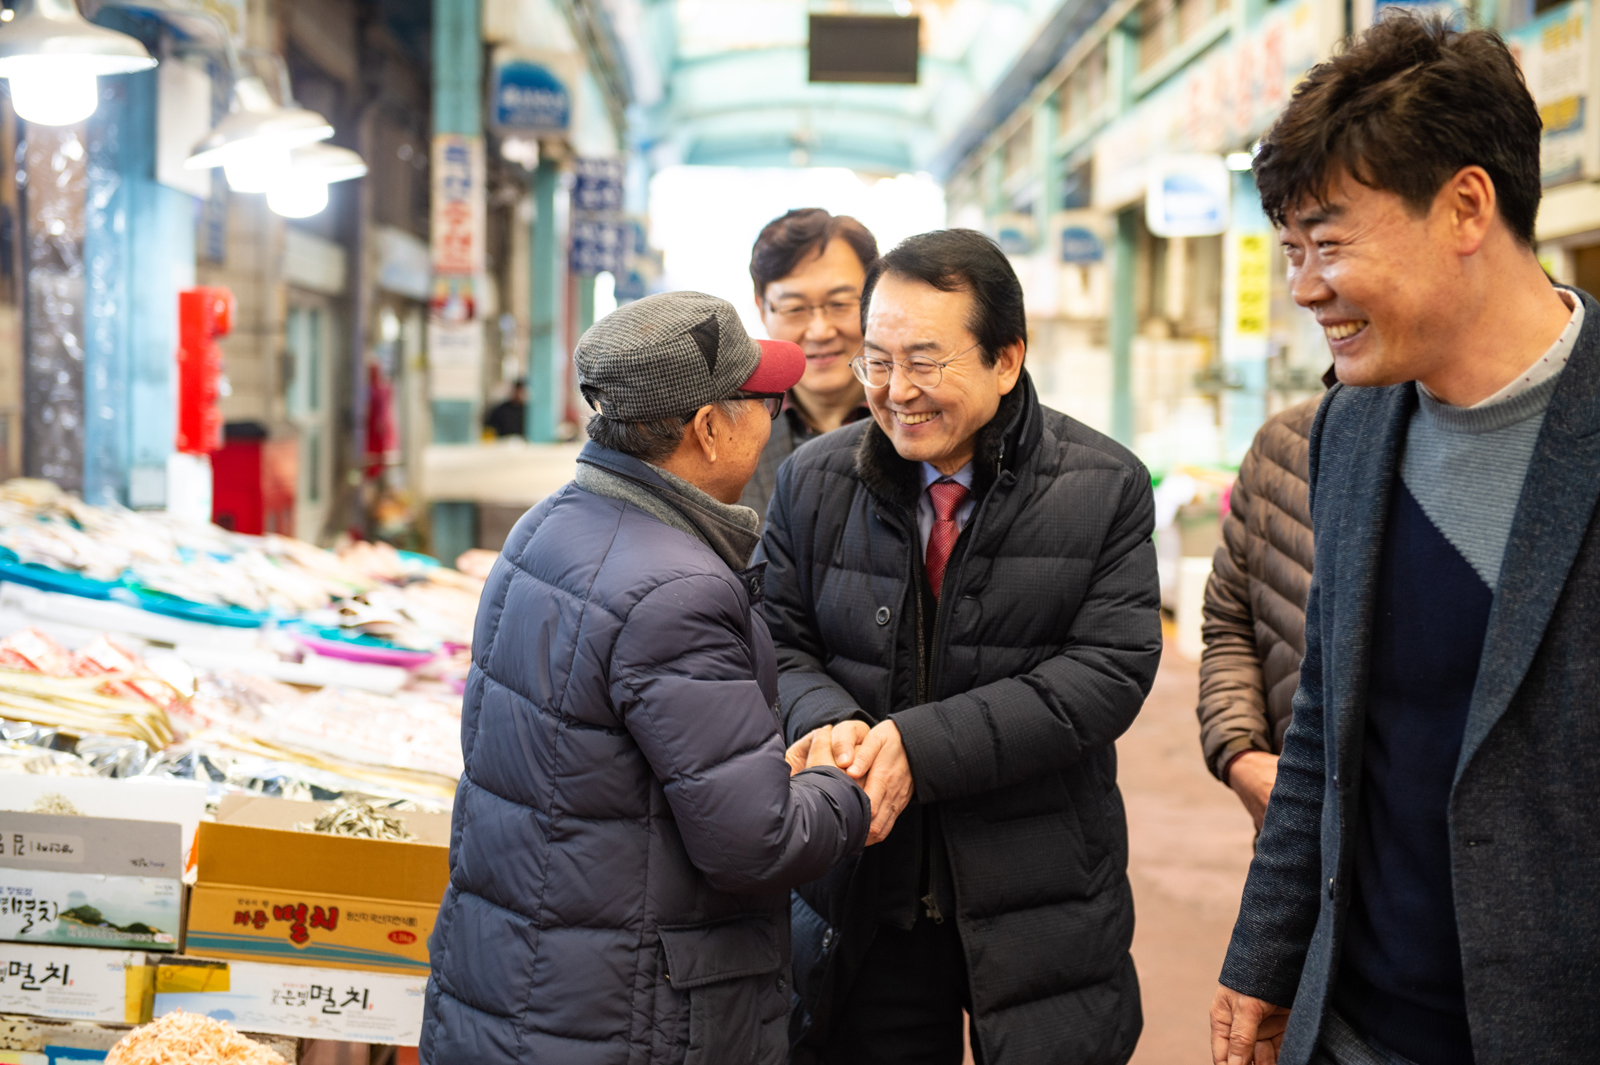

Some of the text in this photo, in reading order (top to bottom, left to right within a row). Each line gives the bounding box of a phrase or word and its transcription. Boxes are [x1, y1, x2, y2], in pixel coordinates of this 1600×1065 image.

[234, 902, 339, 944] 마른 멸치
[9, 960, 70, 991] 멸치
[310, 984, 370, 1015] 멸치
